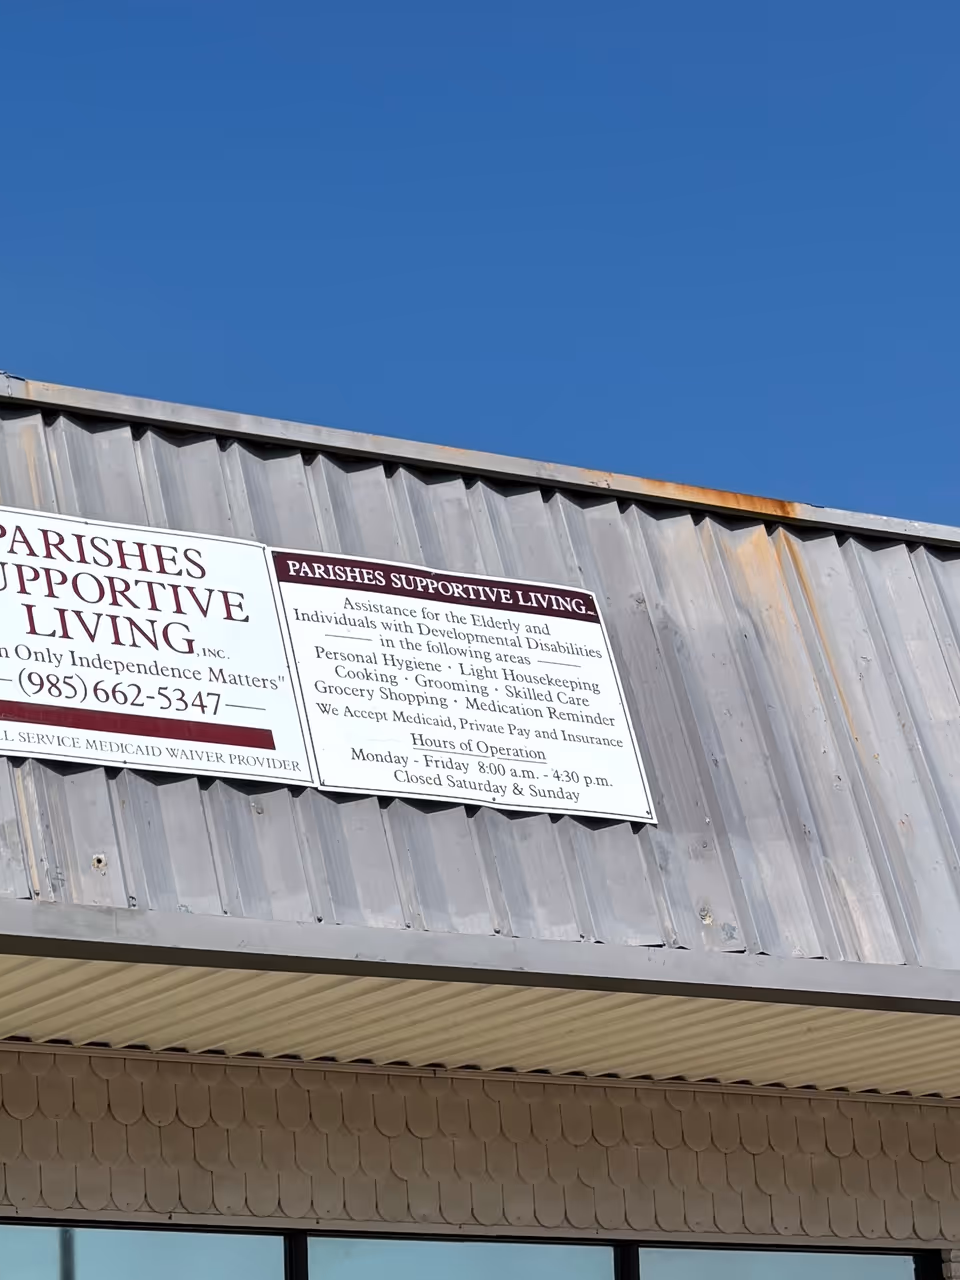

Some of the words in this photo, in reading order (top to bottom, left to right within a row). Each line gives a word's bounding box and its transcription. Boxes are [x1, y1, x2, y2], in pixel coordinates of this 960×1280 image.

[286, 560, 386, 586] PARISHES
[390, 573, 513, 604] SUPPORTIVE
[516, 590, 586, 614] LIVING
[293, 608, 377, 630] Individuals
[381, 619, 414, 634] with
[416, 622, 523, 648] Developmental
[525, 636, 603, 659] Disabilities
[344, 597, 417, 618] Assistance
[421, 606, 440, 621] for
[445, 611, 467, 625] the
[470, 613, 520, 634] Elderly
[525, 624, 551, 636] and
[14, 643, 63, 668] Only
[69, 650, 202, 681] Independence
[208, 666, 285, 691] Matters"
[314, 646, 378, 665] Personal
[381, 652, 442, 673] Hygiene
[458, 662, 499, 680] Light
[501, 668, 601, 695] Housekeeping
[379, 634, 396, 649] in
[399, 637, 423, 652] the
[426, 640, 492, 663] following
[495, 651, 531, 665] areas
[314, 680, 374, 700] Grocery
[379, 686, 448, 709] Shopping
[465, 697, 544, 718] Medication
[546, 706, 615, 727] Reminder
[334, 664, 398, 686] Cooking
[415, 674, 489, 698] Grooming
[505, 685, 554, 703] Skilled
[557, 691, 590, 707] Care
[316, 702, 339, 716] We
[343, 706, 388, 722] Accept
[392, 710, 456, 730] Medicaid,
[459, 717, 505, 734] Private
[507, 723, 531, 739] Pay
[535, 728, 559, 740] and
[561, 729, 624, 748] Insurance
[410, 732, 456, 750] Hours
[460, 738, 473, 752] of
[476, 741, 547, 761] Operation
[18, 732, 82, 749] SERVICE
[85, 739, 162, 757] MEDICAID
[166, 747, 226, 764] WAIVER
[229, 753, 302, 772] PROVIDER
[351, 748, 409, 767] Monday
[423, 754, 469, 774] Friday
[478, 761, 506, 776] 8:00
[510, 768, 539, 780] a.m.
[553, 769, 580, 784] 4:30
[583, 775, 613, 788] p.m.
[394, 769, 442, 786] Closed
[446, 774, 507, 797] Saturday
[512, 782, 525, 797] &
[528, 784, 580, 803] Sunday
